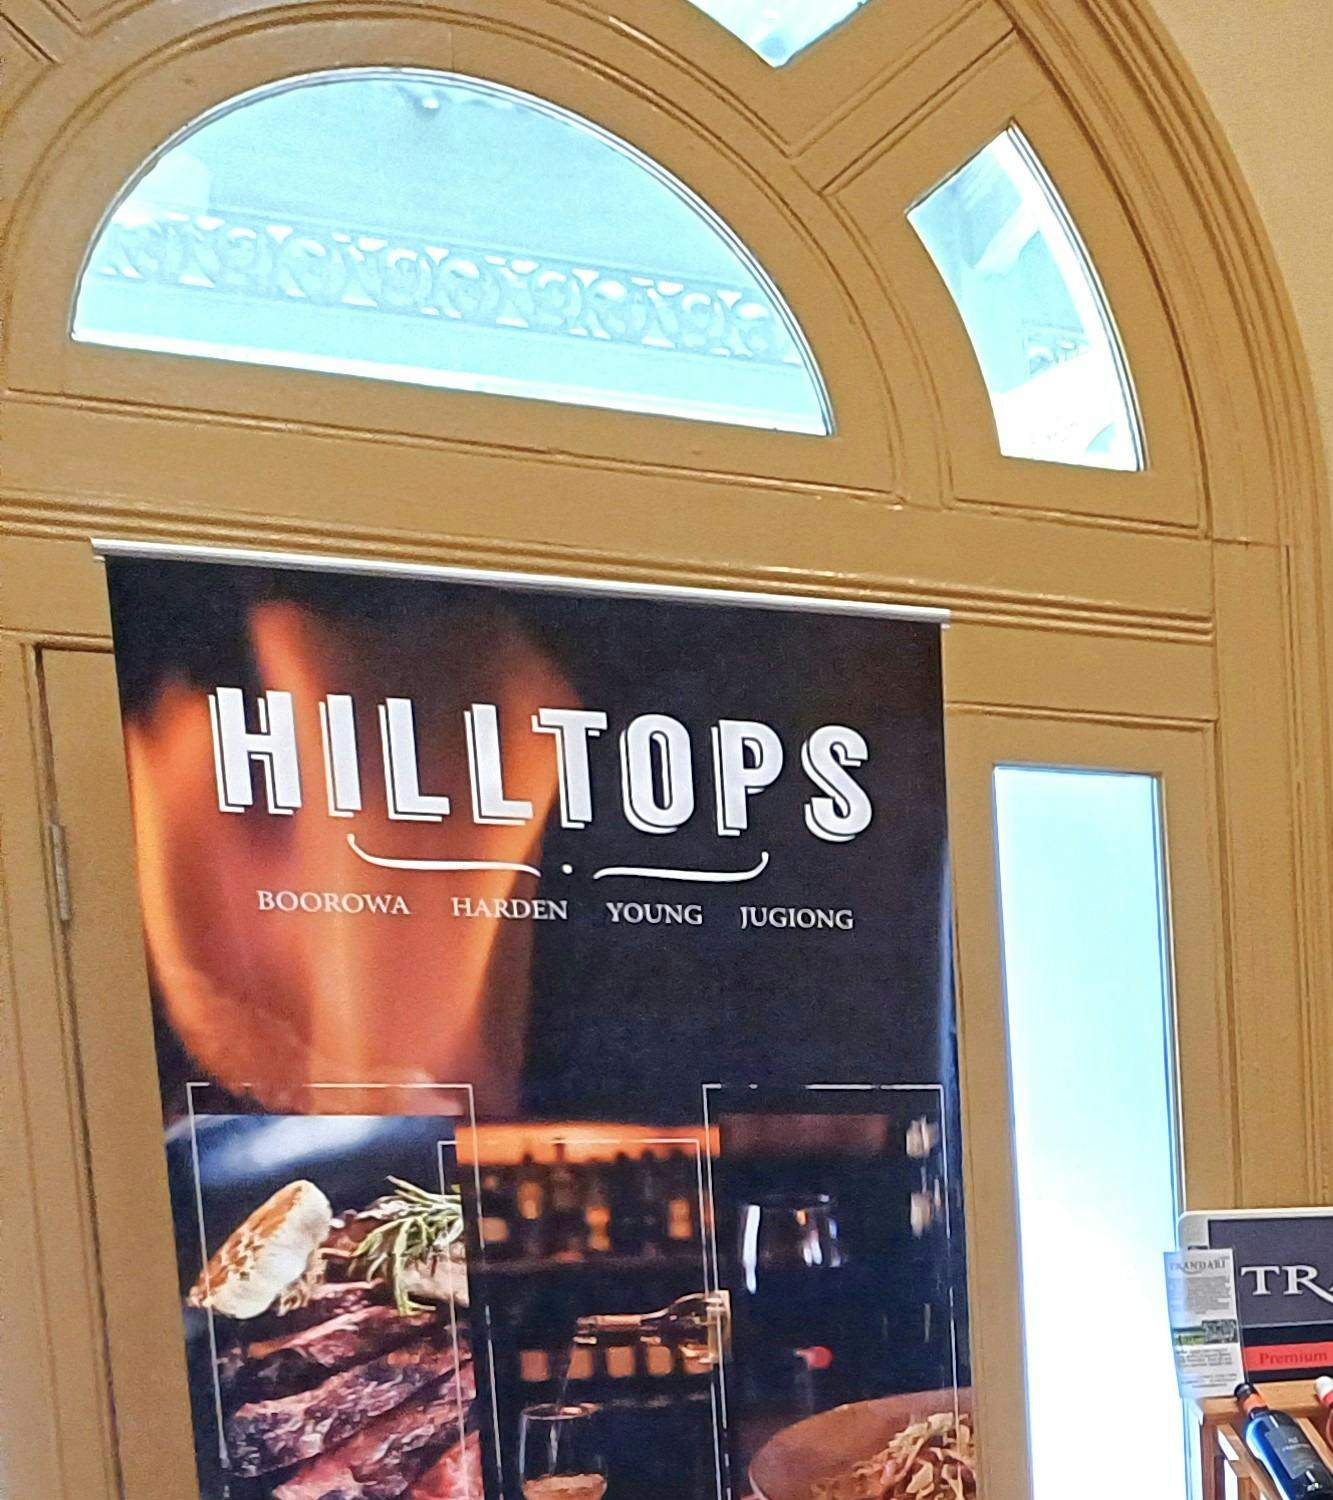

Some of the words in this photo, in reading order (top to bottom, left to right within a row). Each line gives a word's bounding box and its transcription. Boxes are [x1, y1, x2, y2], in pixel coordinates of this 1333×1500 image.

[208, 687, 874, 841] HILLTOPS
[256, 888, 412, 916] BOOROWA
[451, 896, 568, 922] HARDEN
[606, 900, 703, 927] YOUNG
[739, 903, 855, 931] JUGIONG
[1259, 1350, 1328, 1367] Premium
